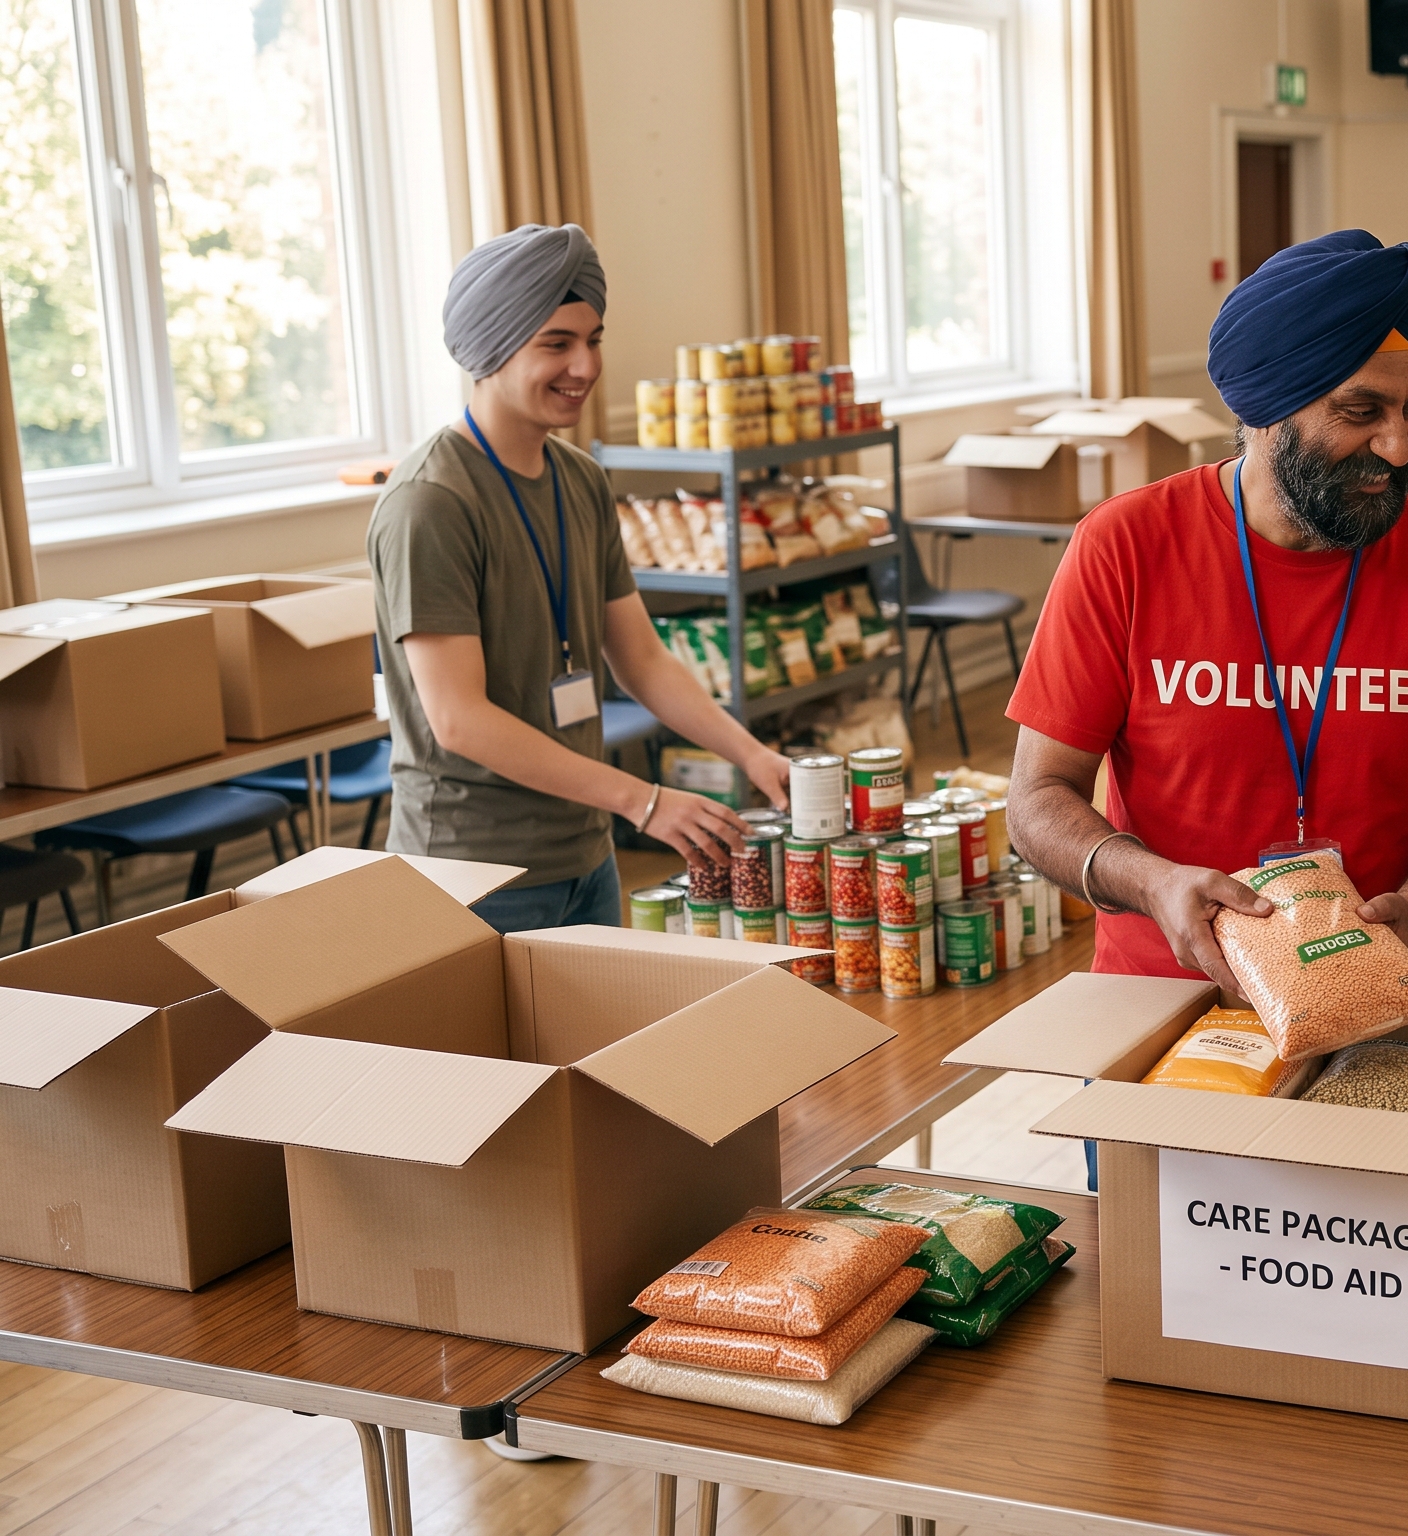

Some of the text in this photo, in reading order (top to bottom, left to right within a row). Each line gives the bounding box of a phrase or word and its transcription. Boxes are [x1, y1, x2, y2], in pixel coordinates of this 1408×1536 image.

[1187, 1200, 1271, 1234] CARE
[1241, 1255, 1334, 1290] FOOD
[1343, 1268, 1402, 1298] AID
